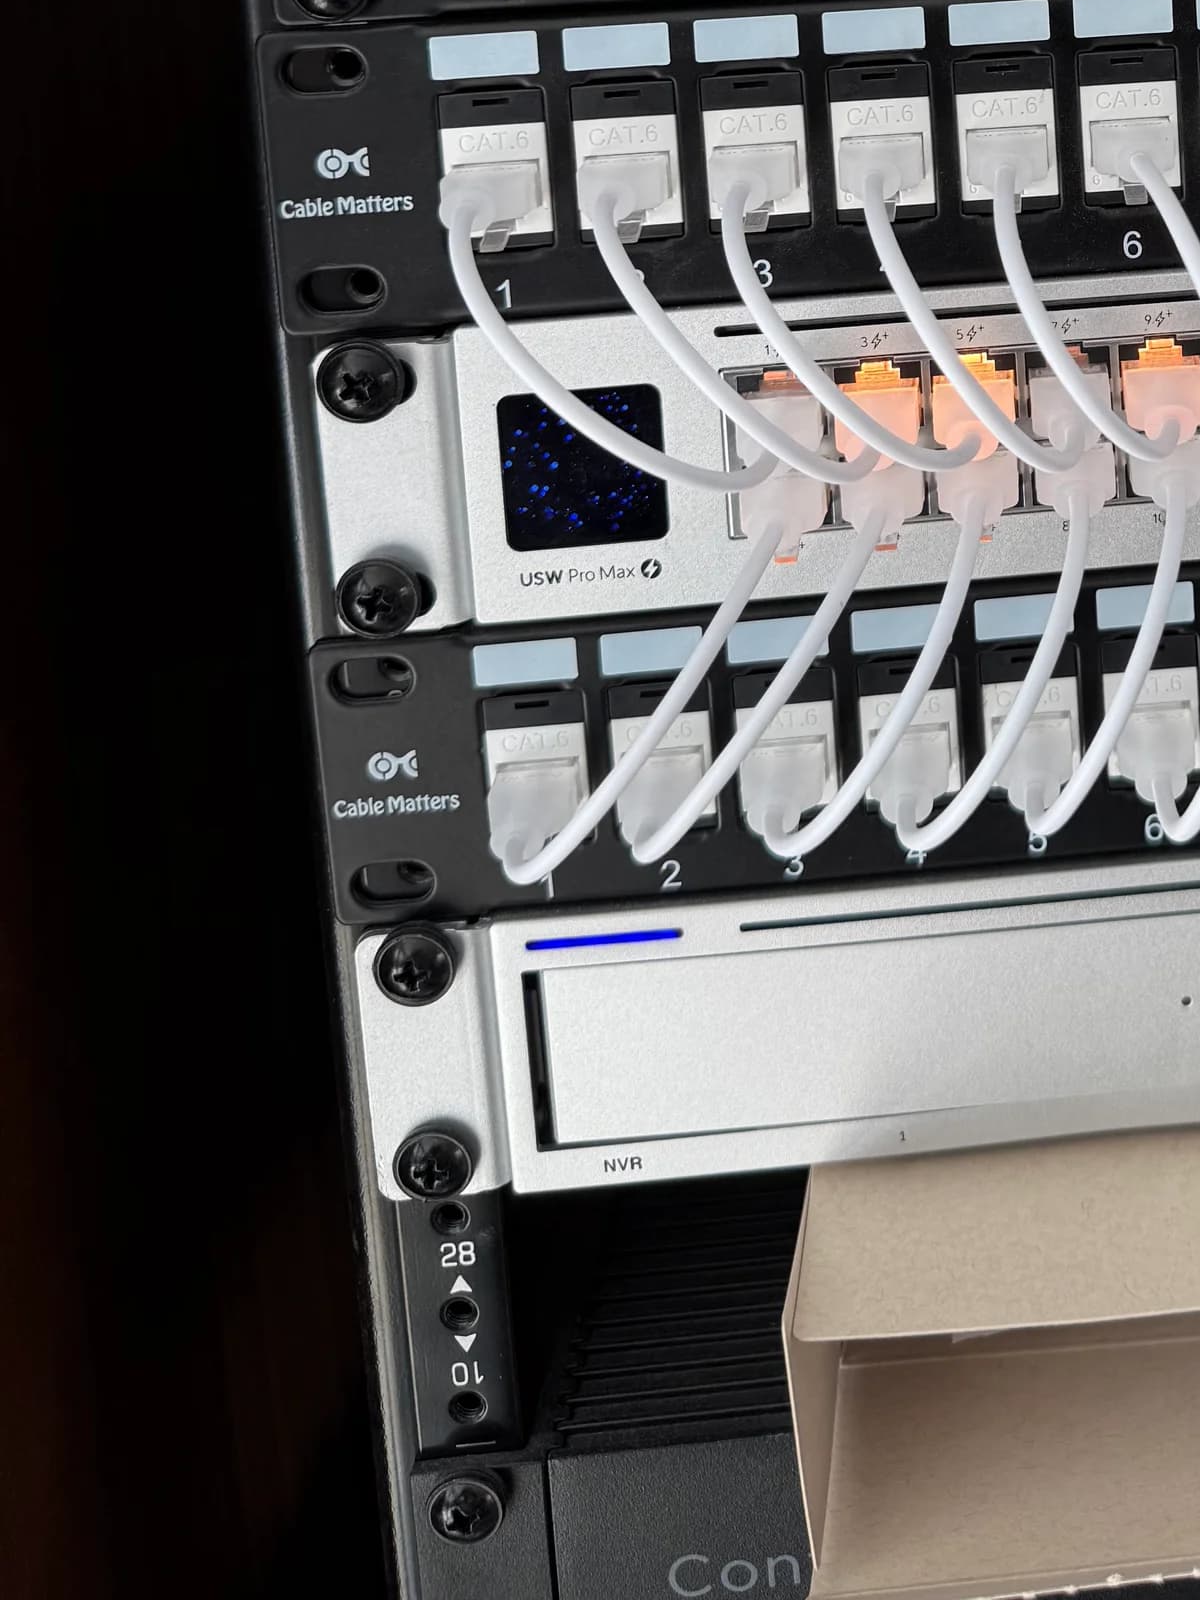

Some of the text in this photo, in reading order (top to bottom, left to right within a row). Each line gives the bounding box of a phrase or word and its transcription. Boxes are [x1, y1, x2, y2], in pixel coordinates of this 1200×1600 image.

[280, 195, 414, 219] Cable Matters
[1123, 230, 1143, 259] 6
[753, 260, 773, 288] 3
[496, 279, 512, 309] 1
[519, 565, 636, 587] USW Pro Max
[333, 793, 461, 819] Cable Matters
[1145, 814, 1165, 843] 6
[1028, 832, 1048, 856] 5
[661, 859, 682, 889] 2
[603, 1156, 643, 1173] NVR
[439, 1241, 476, 1268] 28
